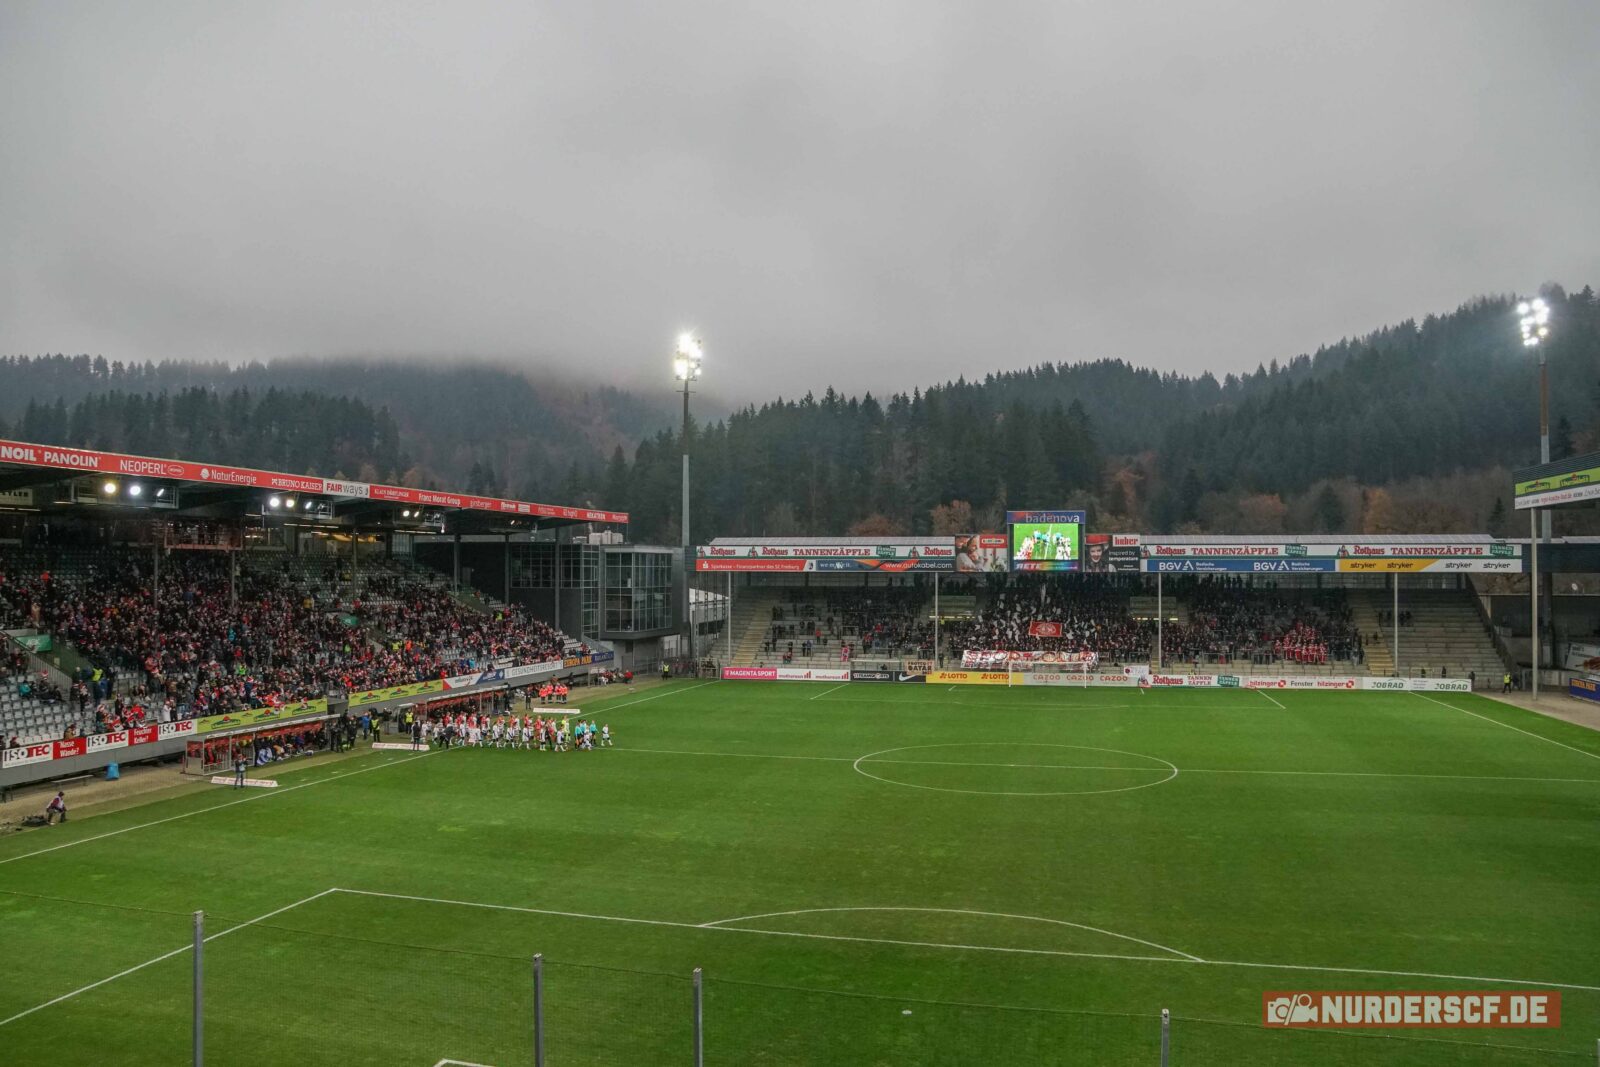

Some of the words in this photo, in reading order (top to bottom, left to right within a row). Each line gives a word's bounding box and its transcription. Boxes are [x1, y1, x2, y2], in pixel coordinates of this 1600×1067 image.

[44, 451, 98, 468] PANOLIN
[120, 459, 164, 475] NEOPERL
[211, 468, 257, 486] NaturEnergie
[278, 478, 299, 489] BRUNO
[301, 480, 323, 491] KAISER
[326, 482, 363, 495] FAIRways
[1025, 512, 1080, 523] badenova
[1114, 537, 1138, 546] huber
[710, 546, 736, 556] Rothaus
[762, 546, 788, 556] Rothaus
[793, 547, 870, 556] TANNENZÄPFLE
[924, 546, 952, 556] Rothaus
[1156, 546, 1186, 556] Rothaus
[1191, 546, 1278, 555] TANNENZÄPFLE
[1353, 545, 1385, 556] Rothaus
[1391, 546, 1483, 555] TANNENZÄPFLE
[1159, 562, 1182, 571] BGV
[1253, 562, 1277, 571] BGV
[1350, 562, 1377, 570] stryker
[1387, 562, 1414, 570] stryker
[1445, 562, 1472, 570] stryker
[1483, 562, 1511, 570] stryker
[757, 670, 776, 678] SPORT
[1066, 674, 1094, 682] CAZOO
[1153, 675, 1184, 686] Rothaus
[1250, 680, 1277, 688] hilzinger
[158, 721, 192, 736] ISOTEC
[87, 732, 126, 748] ISOTEC
[3, 744, 50, 762] ISOTEC
